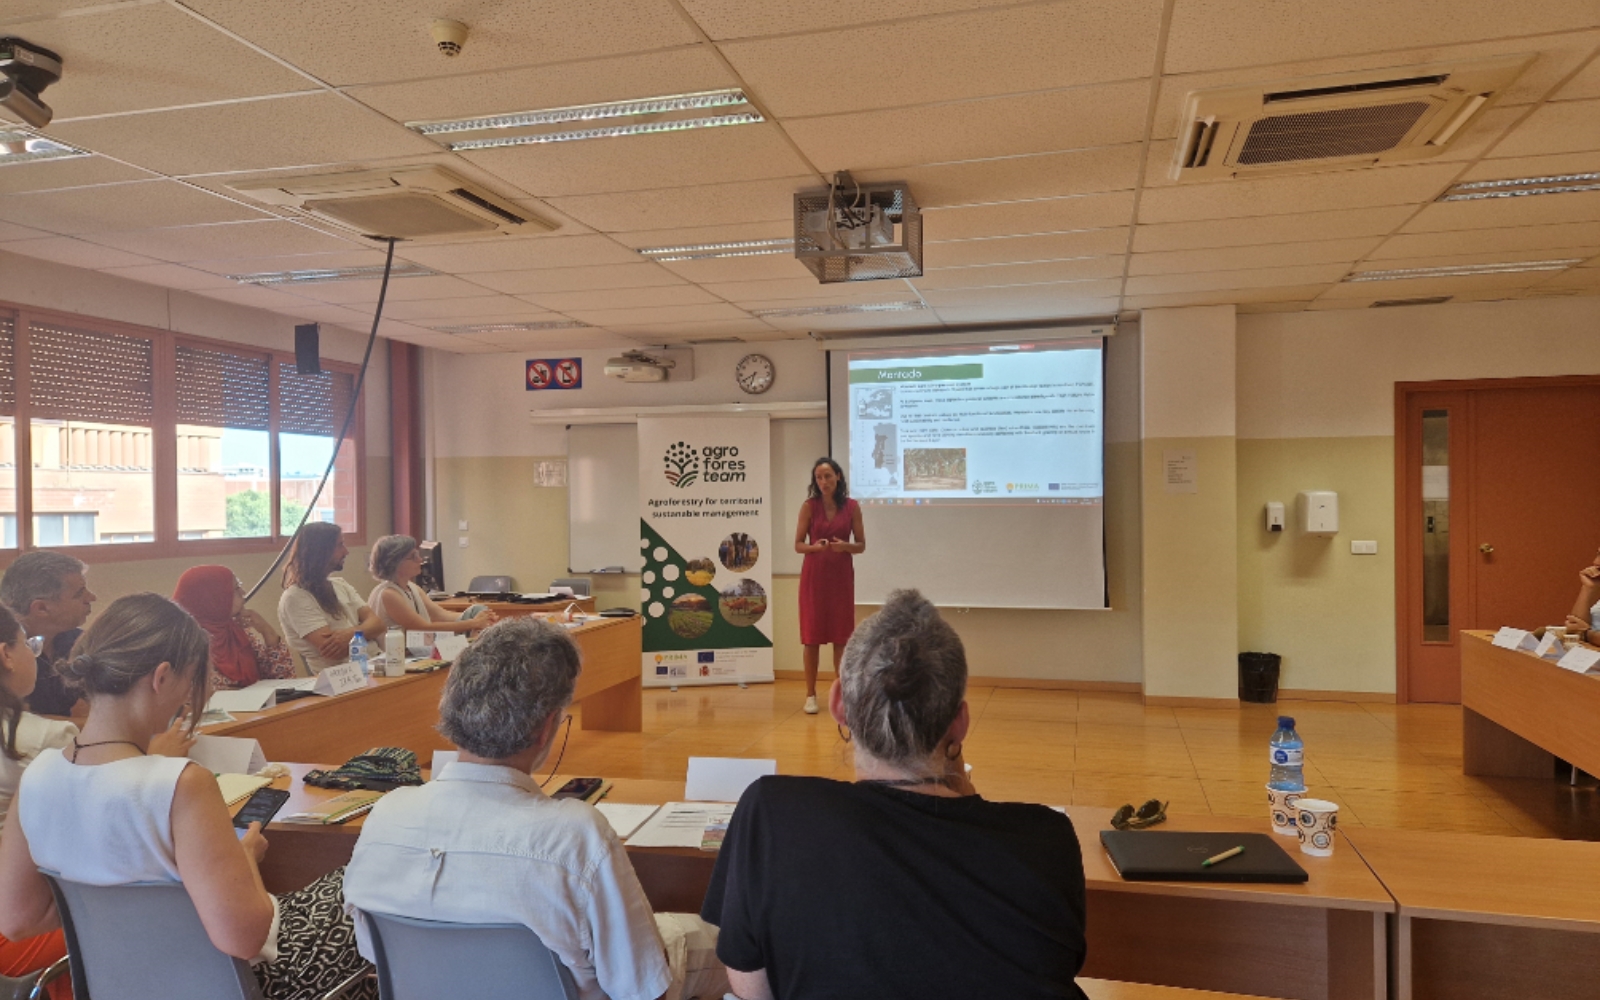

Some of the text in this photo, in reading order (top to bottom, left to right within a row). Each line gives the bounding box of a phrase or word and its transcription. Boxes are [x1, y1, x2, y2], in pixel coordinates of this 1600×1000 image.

[702, 446, 739, 459] agro
[702, 458, 746, 471] fores
[702, 470, 746, 482] team
[648, 497, 763, 507] Agroforestry for territorial
[702, 509, 759, 519] management
